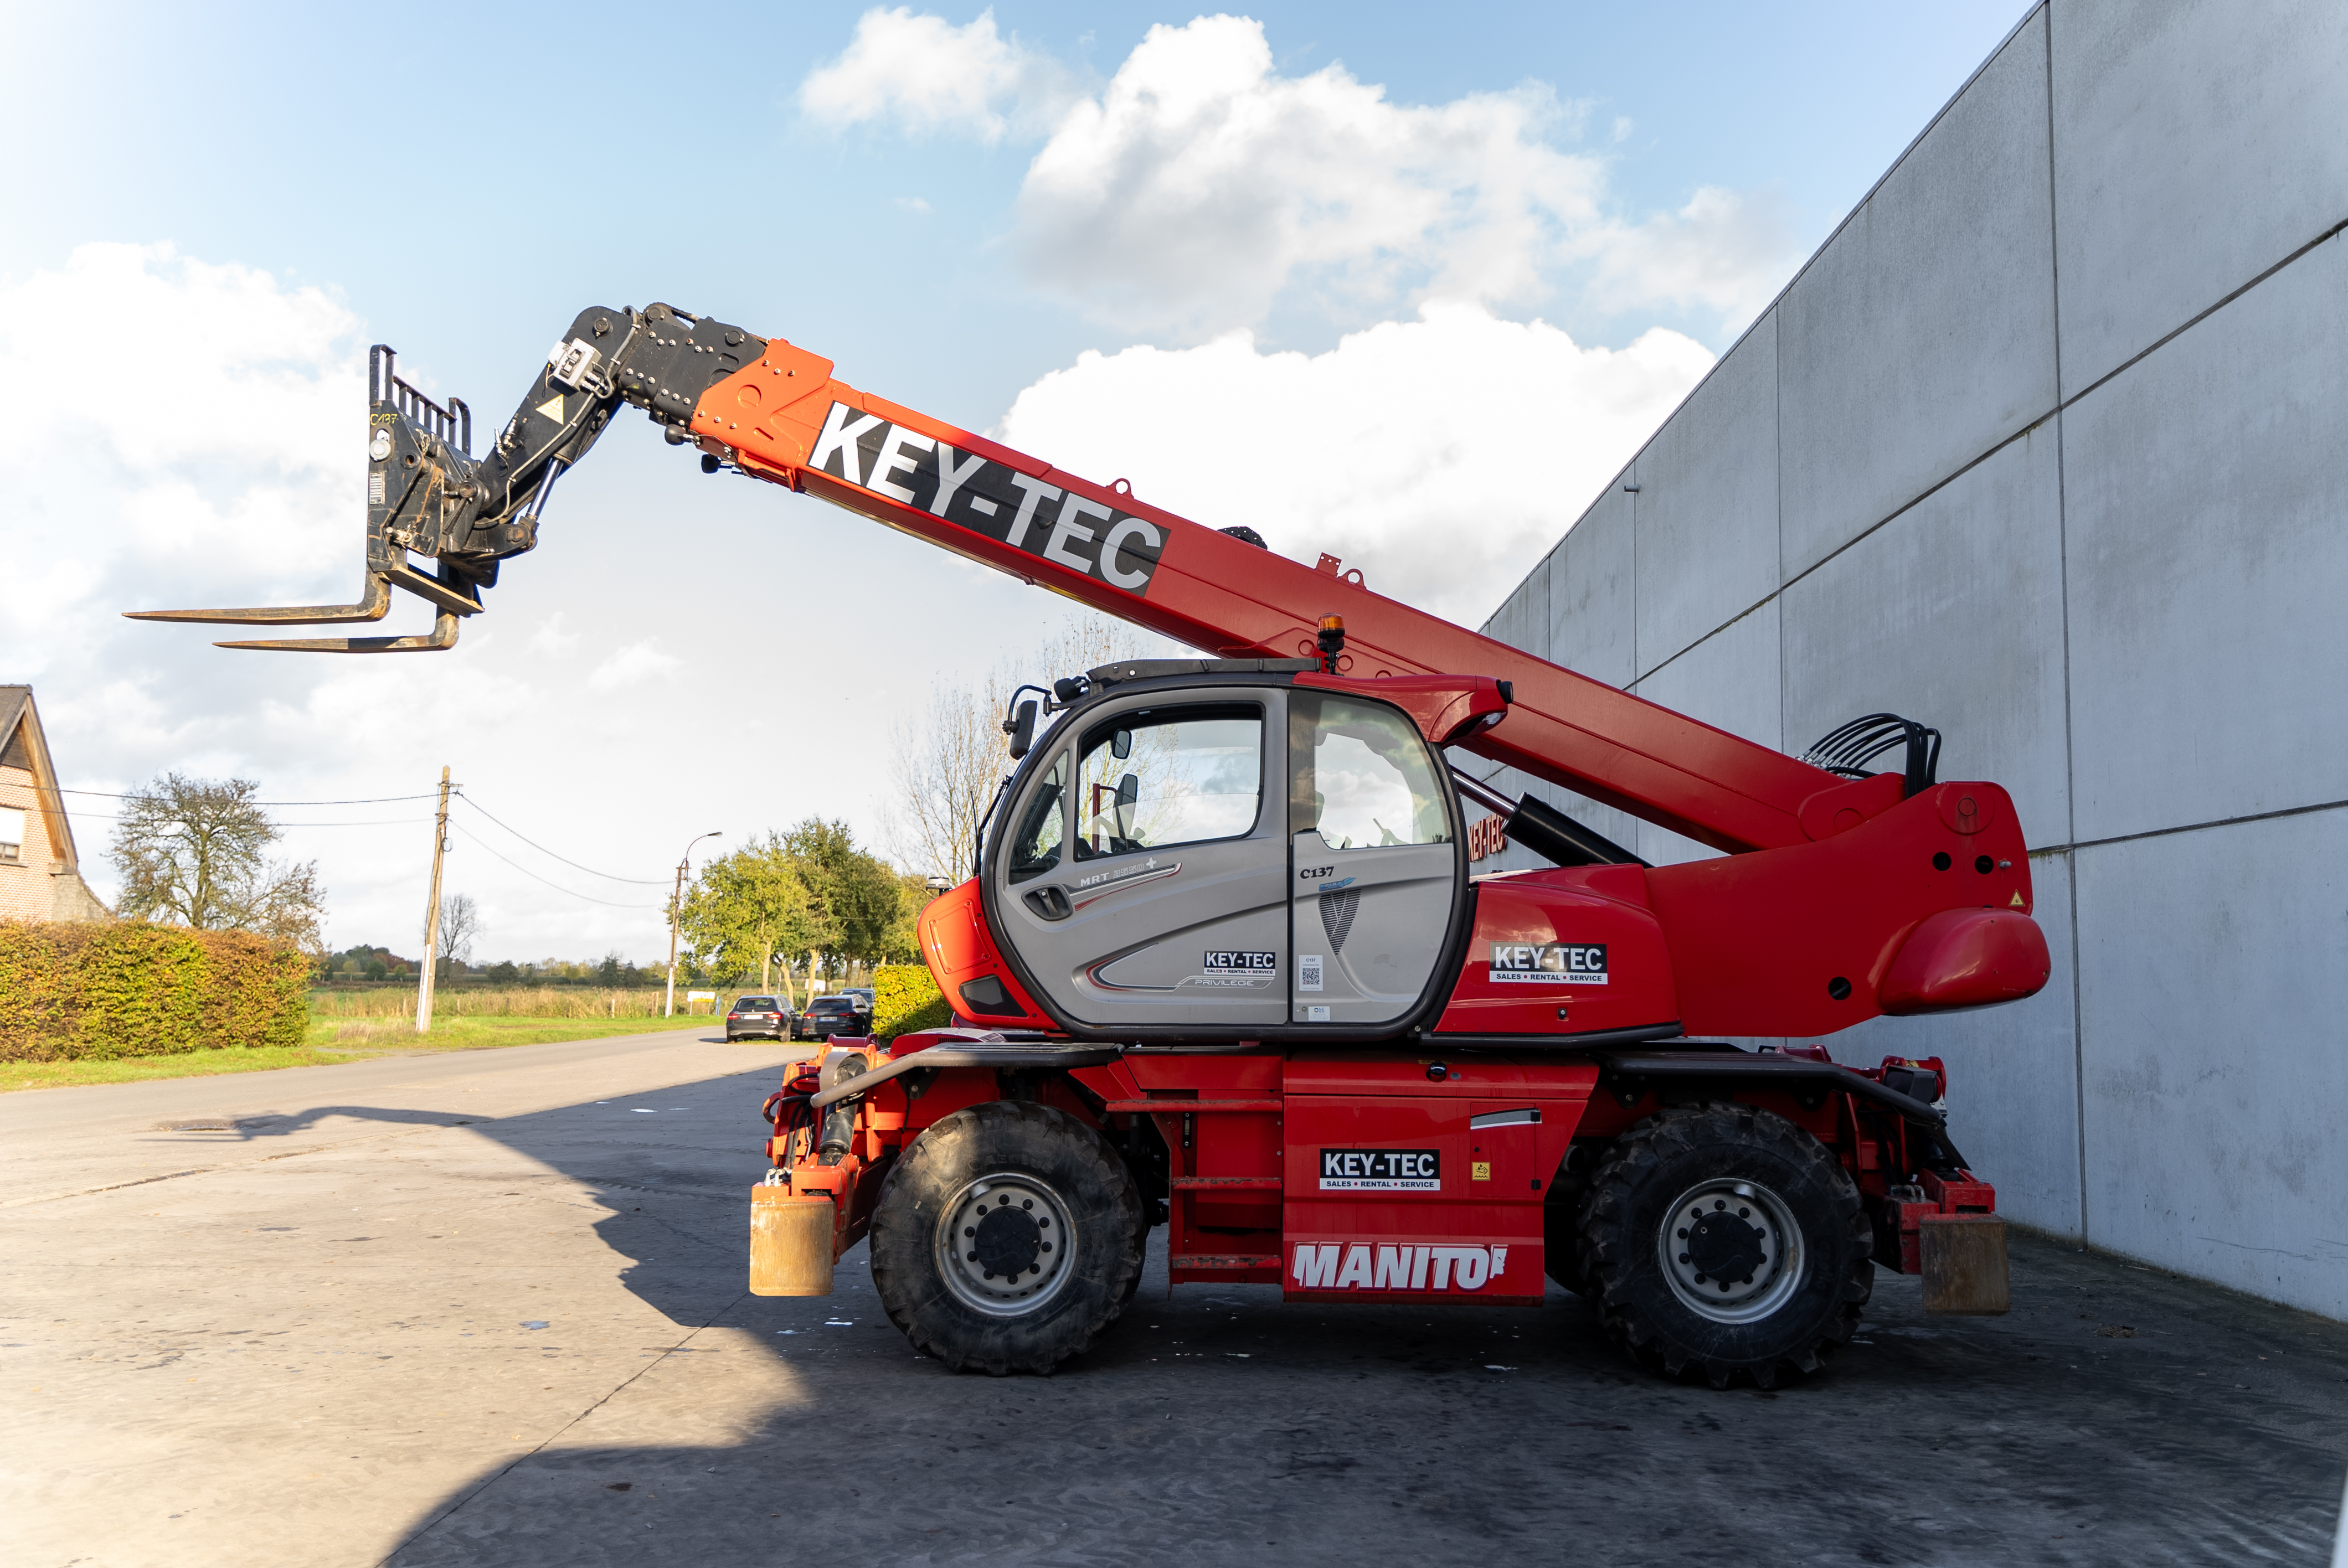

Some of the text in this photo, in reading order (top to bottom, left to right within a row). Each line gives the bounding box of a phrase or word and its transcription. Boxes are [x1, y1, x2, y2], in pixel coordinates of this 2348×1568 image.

[370, 413, 398, 426] C137
[808, 401, 1161, 590] KEY-TEC
[1080, 872, 1110, 887] MRT
[1300, 865, 1335, 879] C137
[1206, 952, 1274, 968] KEY-TEC
[1495, 946, 1602, 970] KEY-TEC
[1325, 1153, 1435, 1177] KEY-TEC
